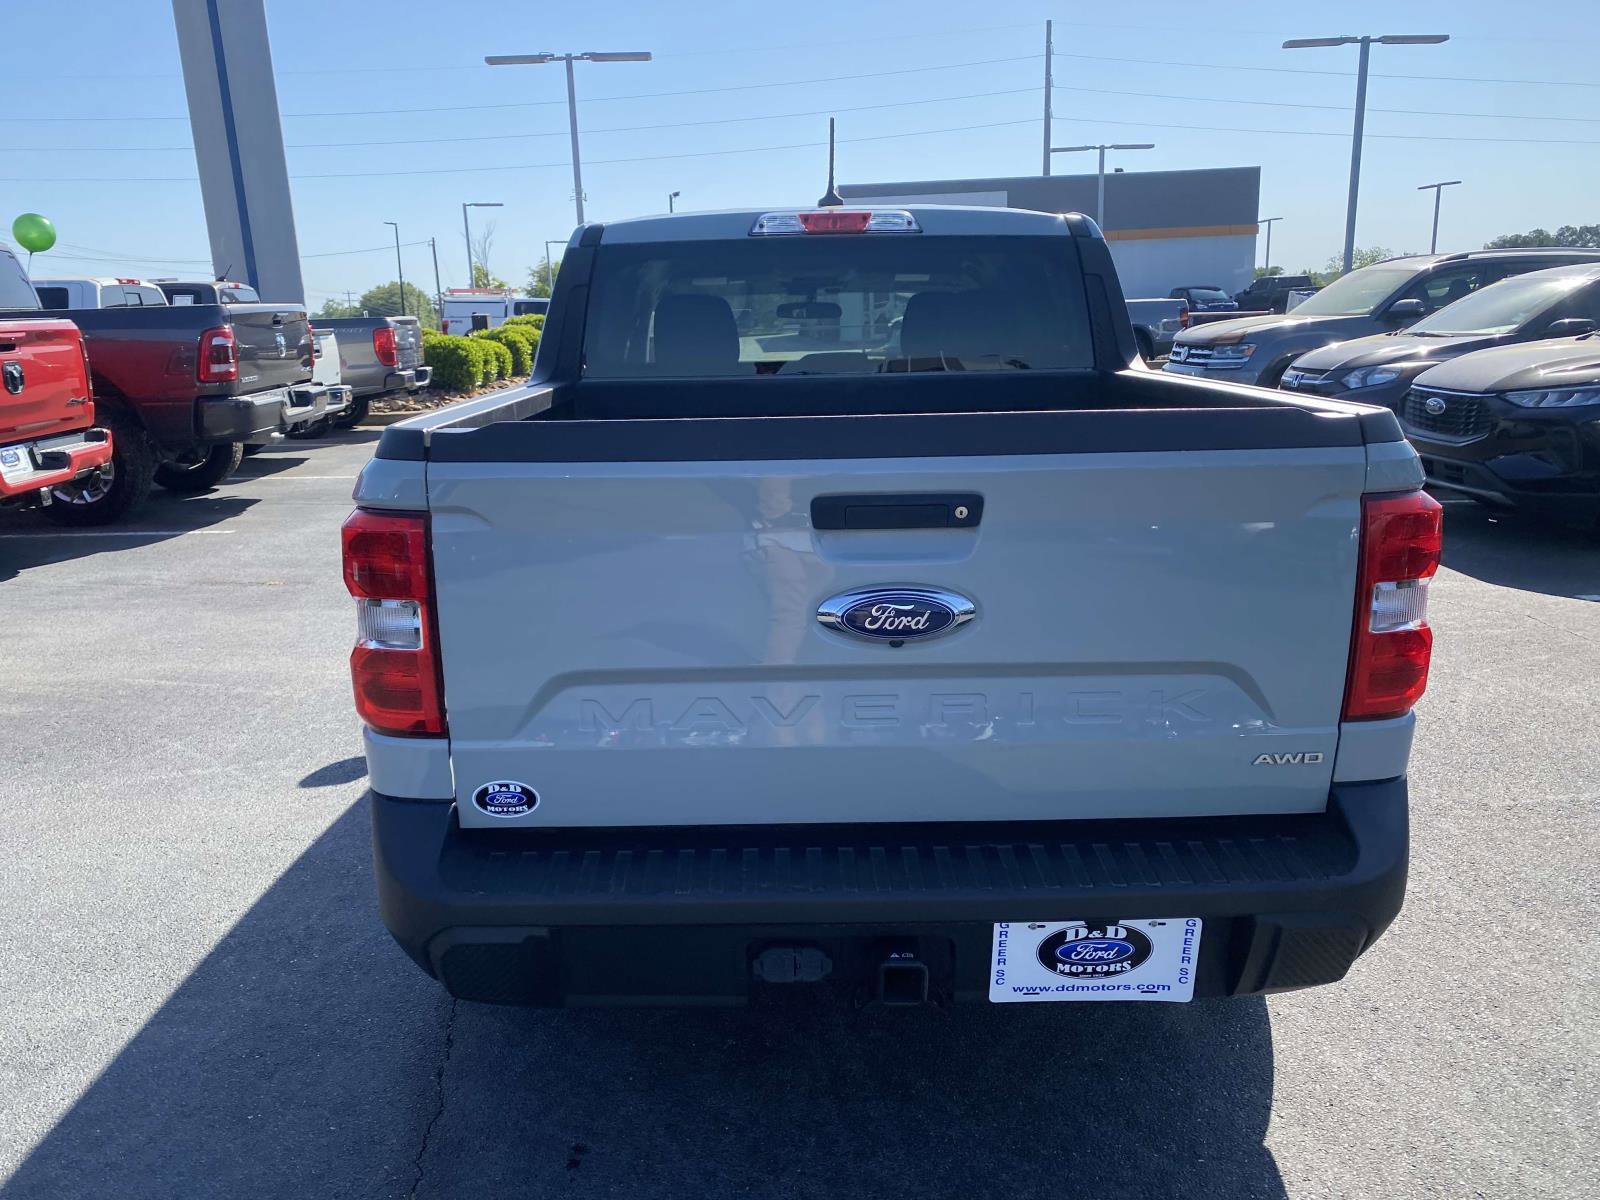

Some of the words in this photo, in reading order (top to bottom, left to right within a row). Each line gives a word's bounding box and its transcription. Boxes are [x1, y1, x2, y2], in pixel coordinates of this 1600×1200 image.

[864, 603, 931, 630] Ford
[577, 689, 1212, 731] MAVERICK
[1251, 752, 1324, 766] AWD
[488, 785, 522, 793] D&D
[494, 795, 519, 804] Ford
[1064, 925, 1128, 941] D&D
[1180, 918, 1197, 965] GREER
[997, 921, 1010, 966] GREER
[1070, 943, 1119, 960] Ford
[1056, 961, 1132, 973] MOTORS
[995, 969, 1006, 986] SC
[1178, 967, 1189, 985] SC
[1012, 982, 1171, 993] www.ddmotors.com
